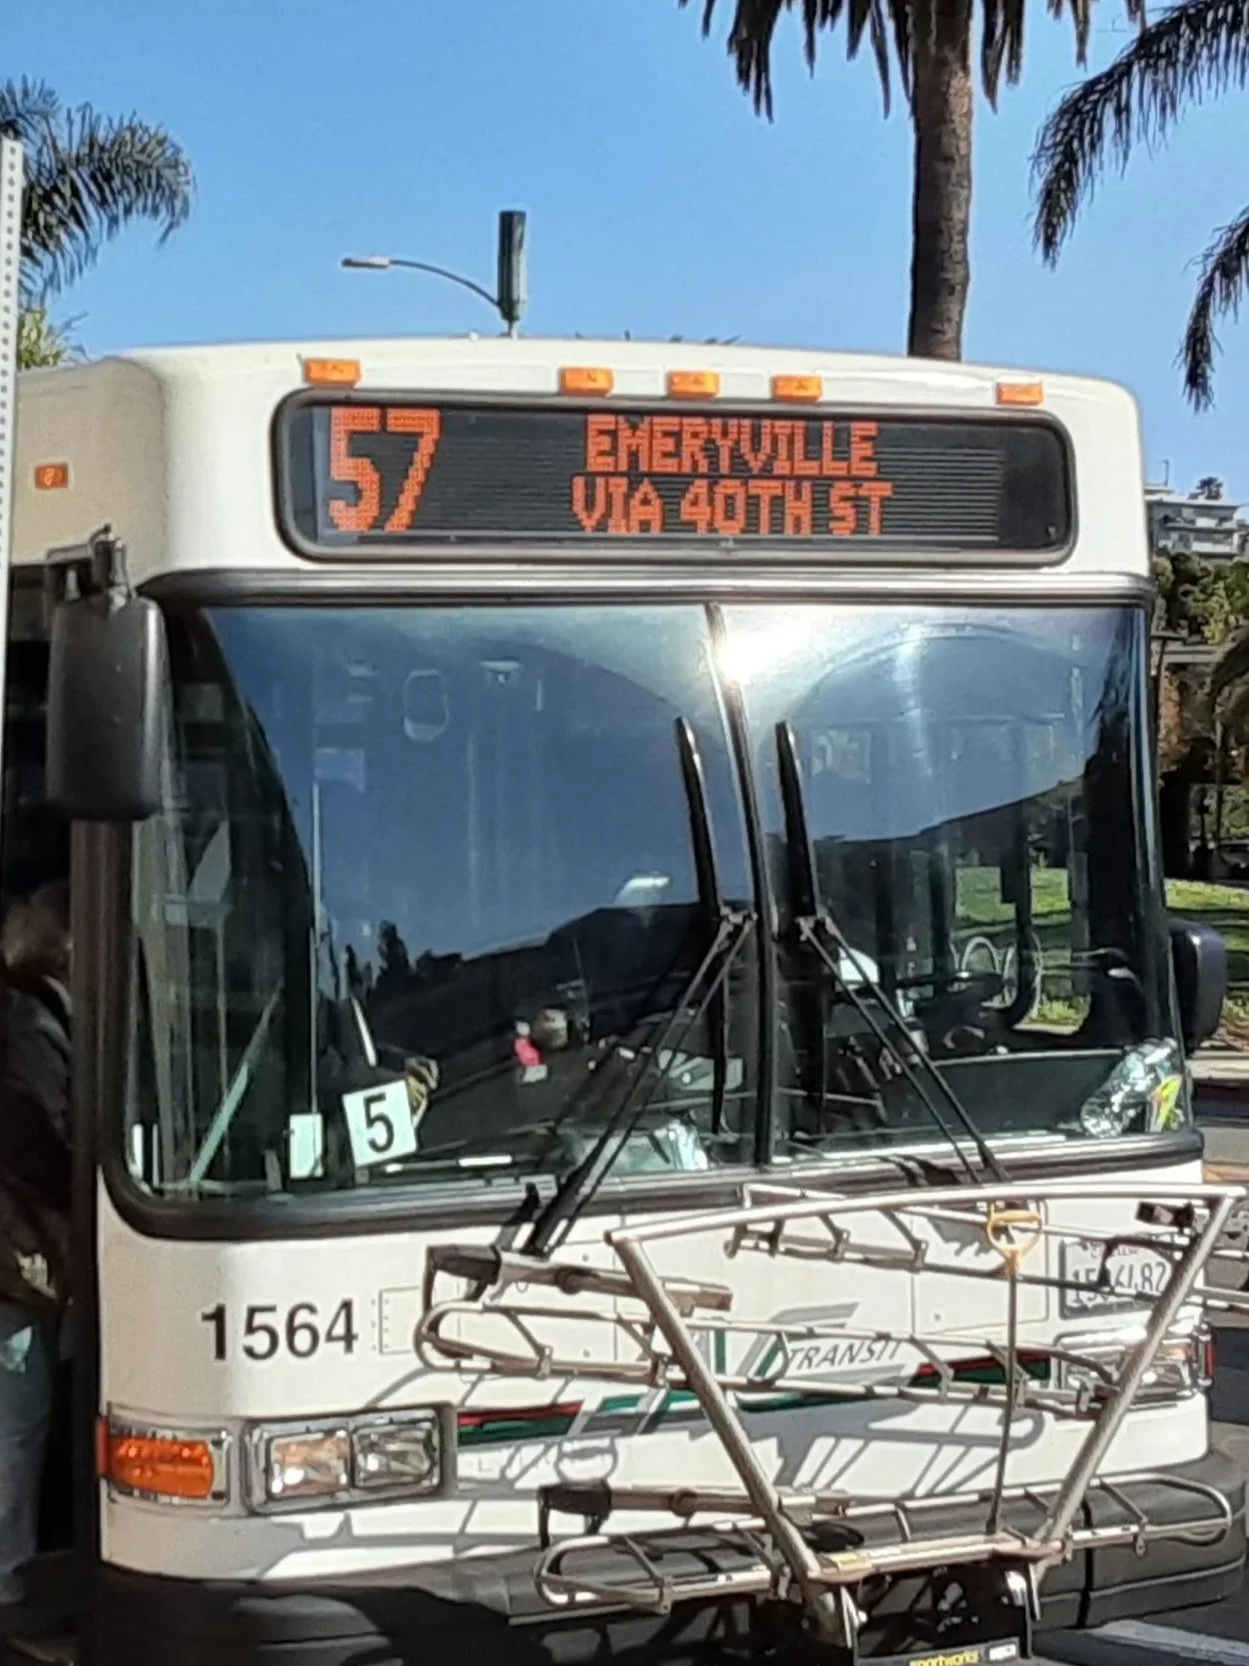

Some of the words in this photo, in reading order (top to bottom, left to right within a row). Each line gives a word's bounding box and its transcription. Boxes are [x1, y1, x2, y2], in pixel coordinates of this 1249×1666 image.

[328, 407, 442, 532] 57
[585, 413, 878, 476] EMERYVILLE
[570, 476, 662, 534] VIA
[678, 480, 812, 534] 40TH
[830, 480, 894, 534] ST
[363, 1091, 395, 1154] 5
[201, 1299, 359, 1362] 1564
[788, 1340, 900, 1371] TRANSIT
